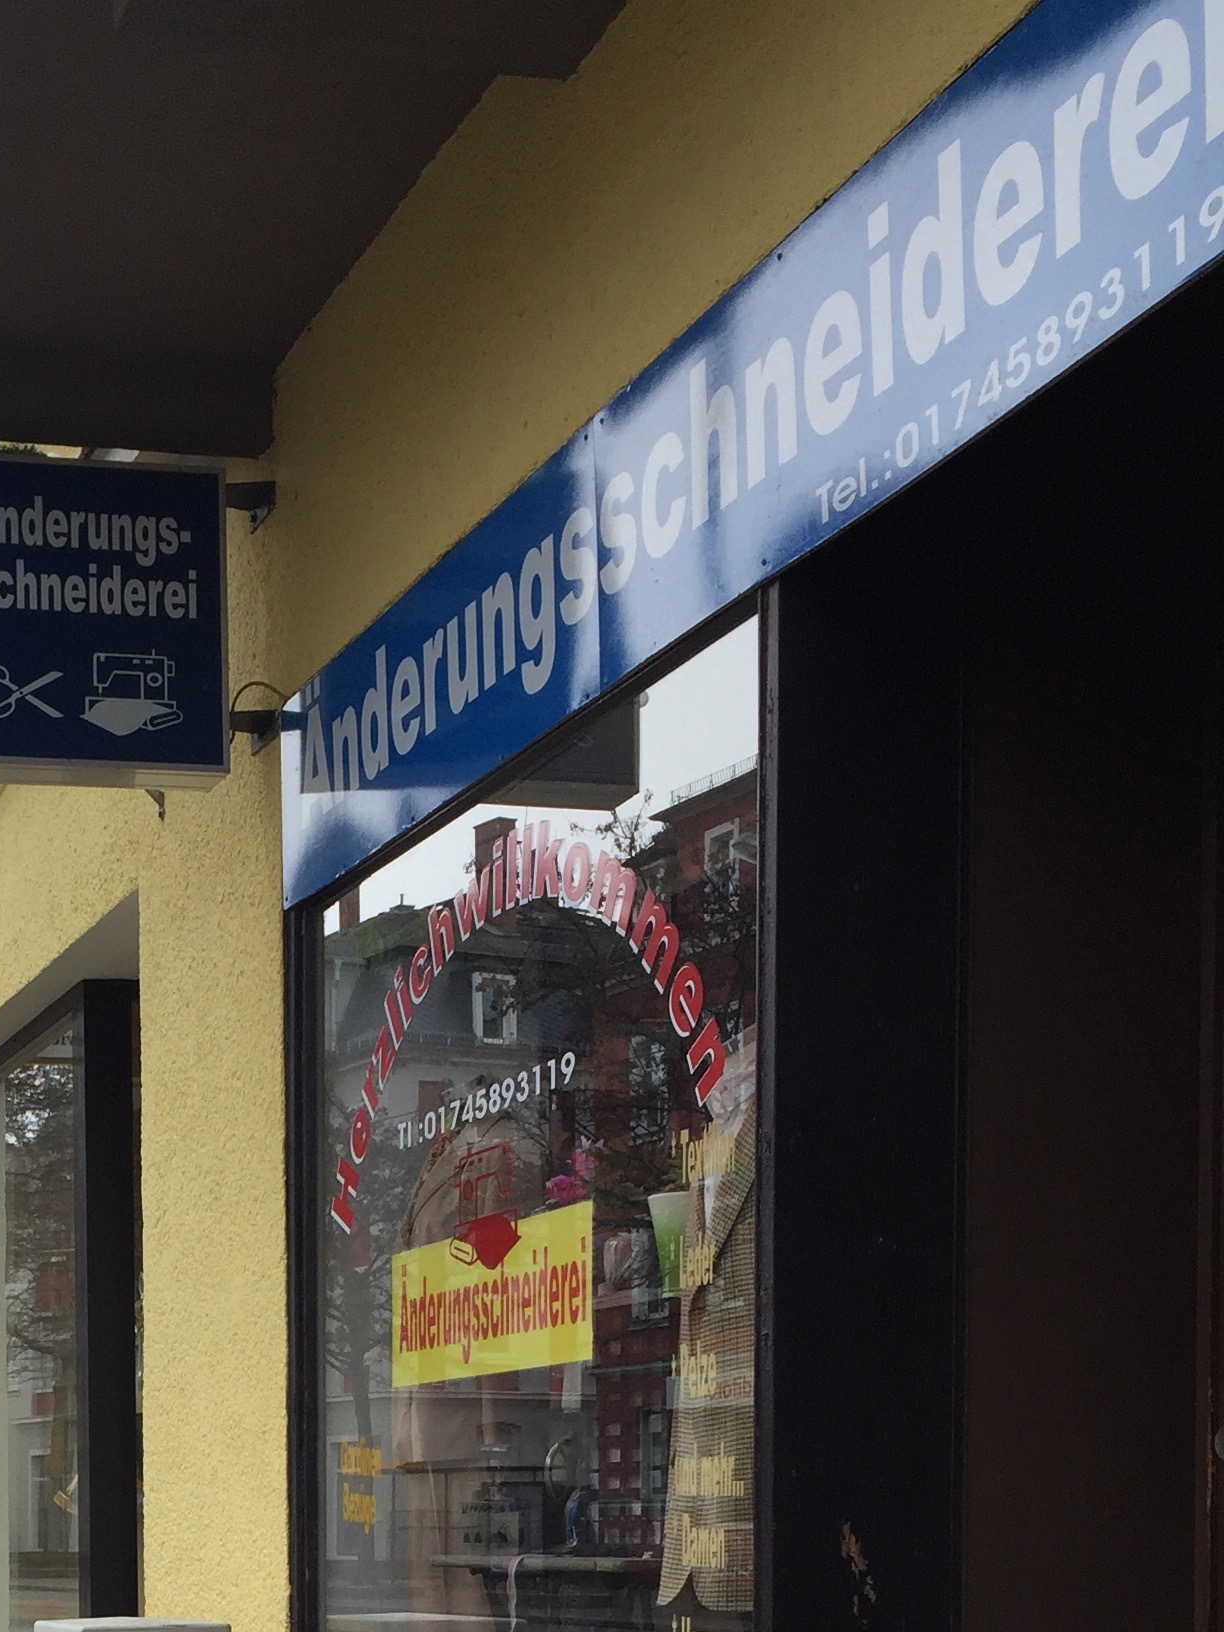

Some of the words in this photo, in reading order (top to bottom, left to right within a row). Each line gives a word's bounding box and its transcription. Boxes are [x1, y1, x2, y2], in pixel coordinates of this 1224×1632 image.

[679, 1231, 716, 1289] Leder
[398, 1235, 588, 1365] Änderungsschneiderei
[681, 1512, 725, 1568] Damen
